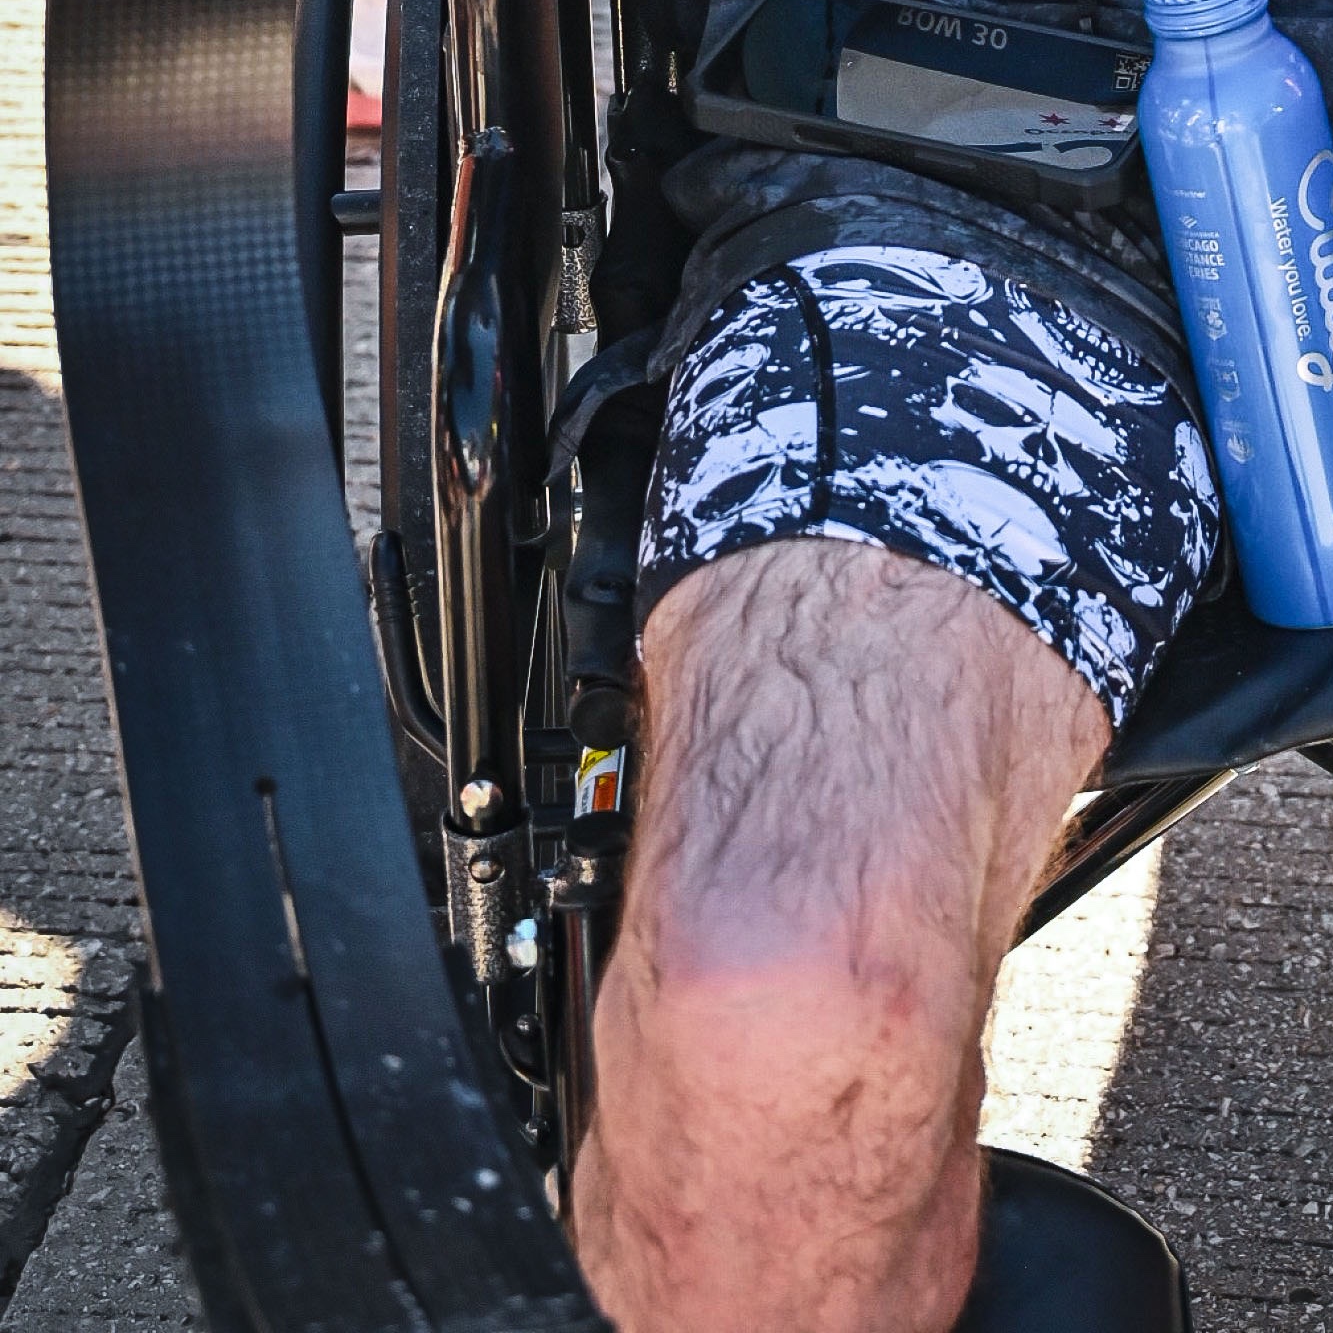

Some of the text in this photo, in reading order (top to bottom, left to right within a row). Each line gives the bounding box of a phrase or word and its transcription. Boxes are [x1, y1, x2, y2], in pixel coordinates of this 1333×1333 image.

[1269, 197, 1313, 341] Water you love.
